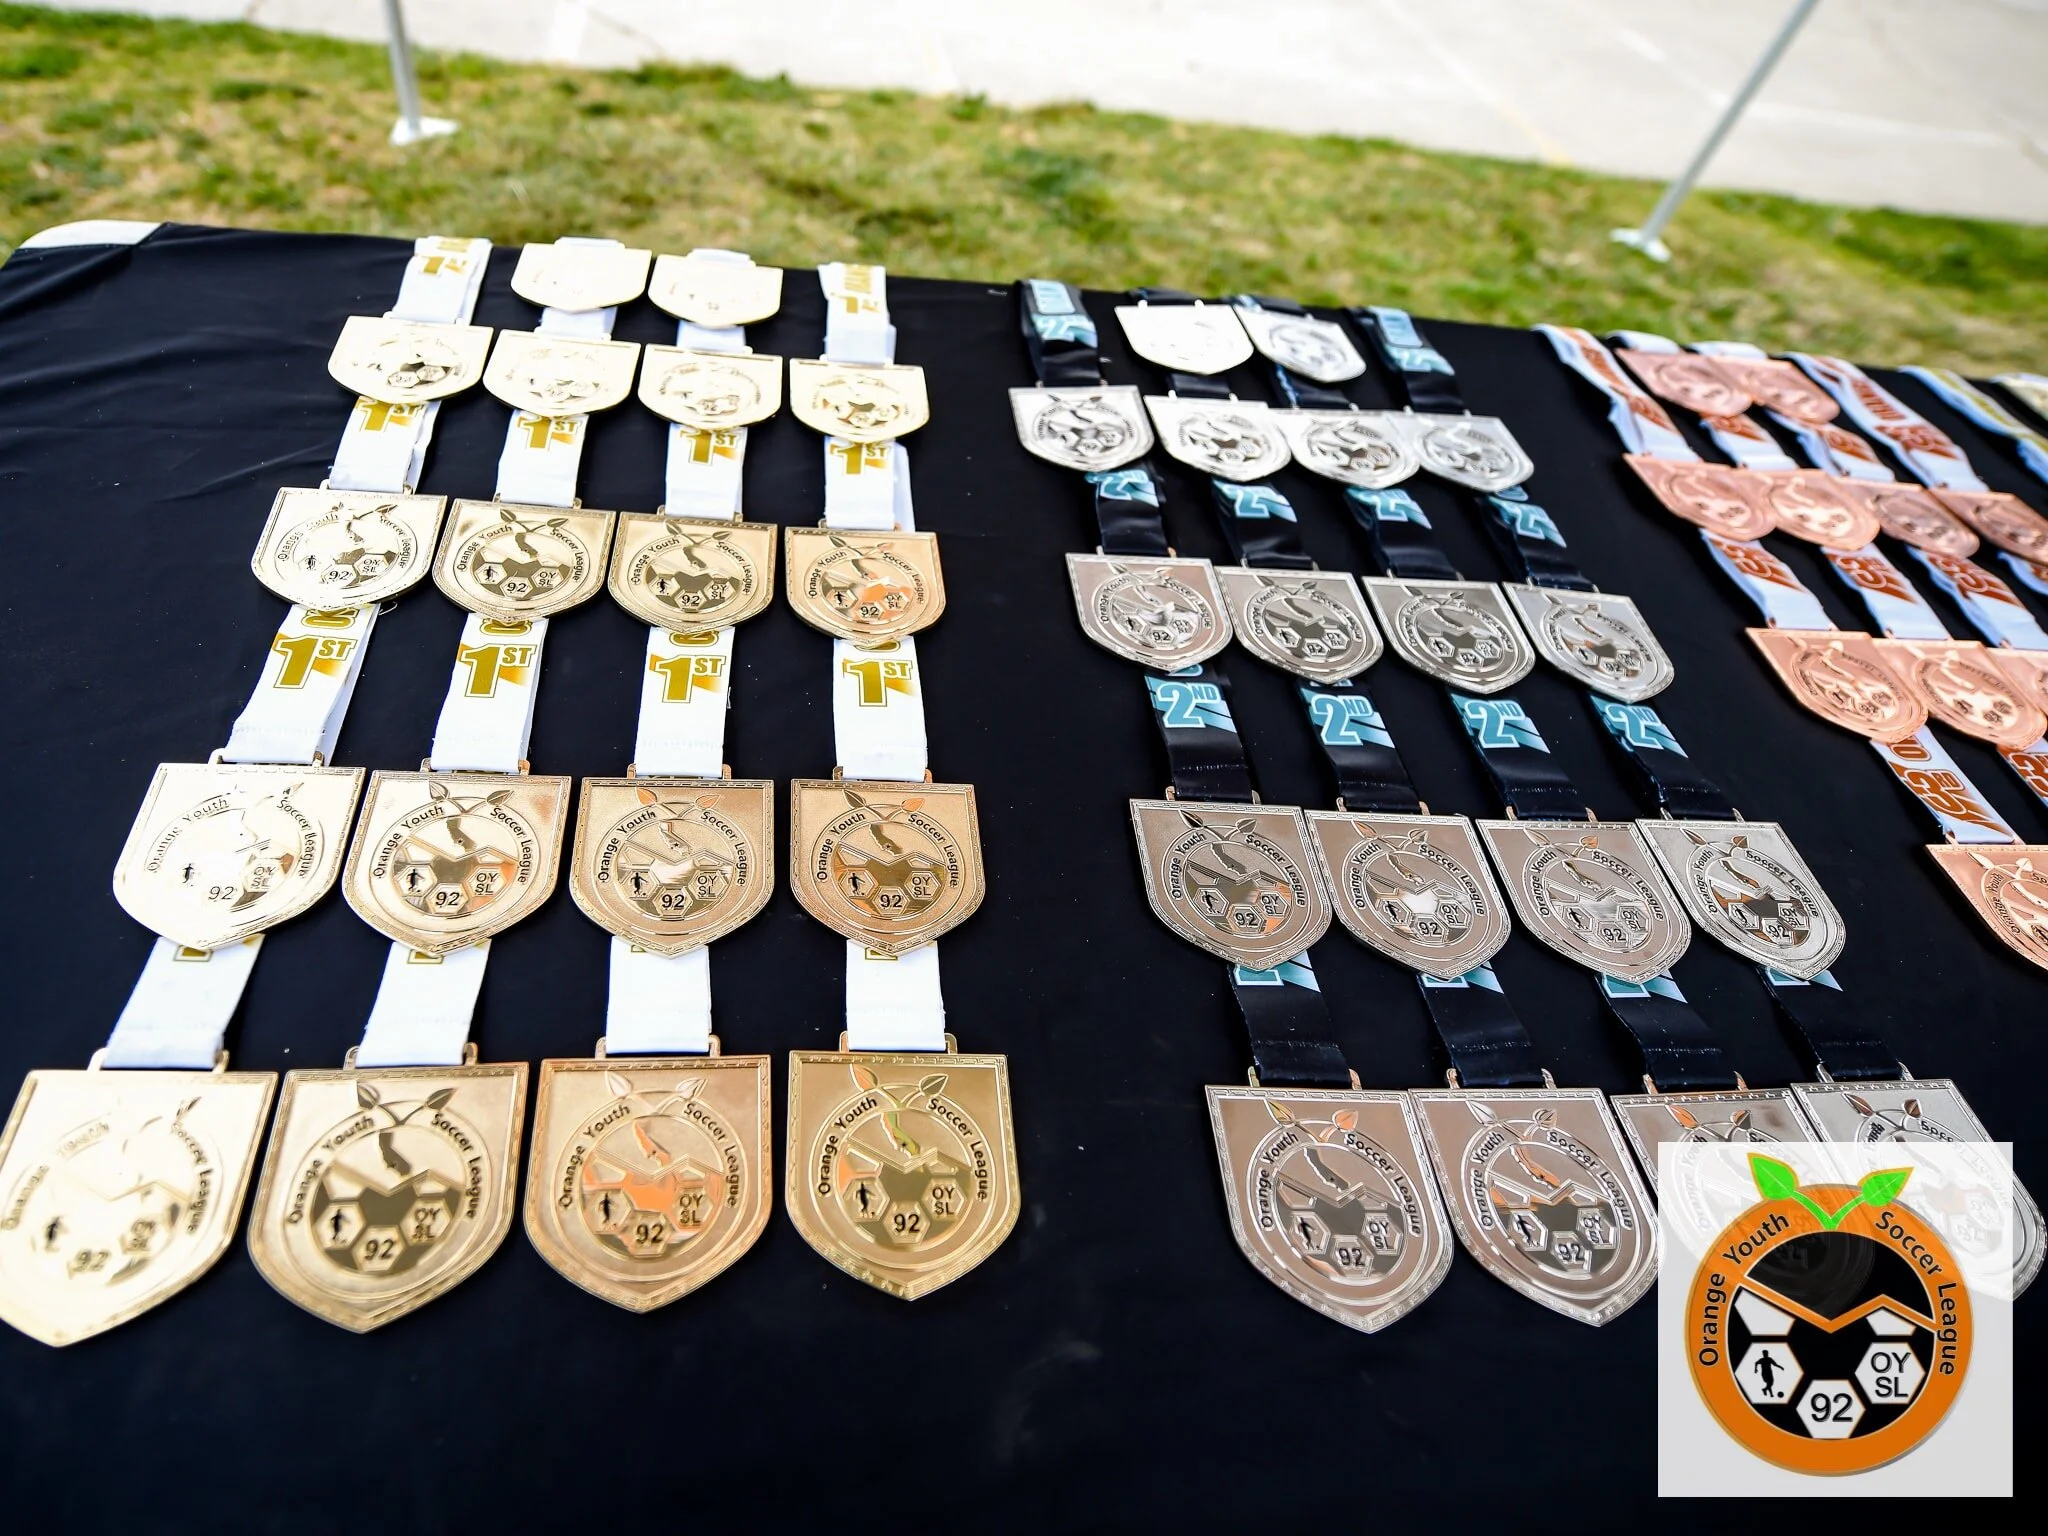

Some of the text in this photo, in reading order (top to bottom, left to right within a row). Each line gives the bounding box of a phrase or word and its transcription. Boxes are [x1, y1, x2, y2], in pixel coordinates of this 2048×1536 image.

[359, 401, 421, 432] 1ST
[521, 416, 581, 450] 1ST
[688, 429, 737, 465] 1ST
[838, 442, 888, 475] 1ST
[457, 525, 584, 582] Orange Youth Soccer League
[328, 569, 350, 581] 92
[538, 571, 557, 579] OY
[629, 537, 753, 595] Orange Youth Soccer League
[506, 581, 528, 593] 92
[538, 578, 552, 587] SL
[810, 551, 924, 604] Orange Youth Soccer League
[681, 595, 700, 605] 92
[711, 591, 725, 601] SL
[860, 605, 879, 617] 92
[1153, 632, 1170, 641] 92
[273, 635, 358, 689] 1ST
[461, 643, 537, 698] 1ST
[655, 654, 726, 703] 1ST
[846, 659, 913, 706] 1ST
[1158, 682, 1220, 728] 2ND
[1312, 694, 1374, 745] 2ND
[1465, 700, 1526, 749] 2ND
[1604, 703, 1663, 749] 2ND
[1904, 769, 1968, 815] 3RD
[372, 805, 534, 884] Orange Youth Soccer League
[598, 808, 748, 887] Orange Youth Soccer League
[817, 811, 959, 888] Orange Youth Soccer League
[476, 872, 498, 883] OY
[1168, 831, 1306, 907] Orange Youth Soccer League
[1350, 842, 1485, 916] Orange Youth Soccer League
[475, 883, 494, 896] SL
[697, 875, 718, 886] OY
[911, 876, 931, 886] OY
[1529, 849, 1665, 922] Orange Youth Soccer League
[1693, 849, 1819, 918] Orange Youth Soccer League
[435, 891, 460, 907] 92
[698, 885, 716, 897] SL
[913, 885, 931, 897] SL
[1261, 895, 1280, 906] OY
[662, 894, 686, 910] 92
[880, 894, 902, 909] 92
[1264, 904, 1283, 915] SL
[1441, 904, 1459, 915] OY
[1235, 912, 1258, 927] 92
[1418, 921, 1442, 937] 92
[1443, 914, 1463, 925] SL
[1603, 927, 1627, 943] 92
[1765, 924, 1791, 940] 92
[559, 1102, 740, 1209] Orange Youth Soccer League
[818, 1096, 988, 1202] Orange Youth Soccer League
[1472, 1132, 1505, 1164] Youth
[1549, 1130, 1597, 1169] Soccer
[287, 1112, 482, 1224] Orange Youth Soccer League
[931, 1186, 956, 1200] OY
[1260, 1131, 1421, 1236] Orange Youth Soccer League
[679, 1193, 703, 1209] OY
[933, 1200, 956, 1216] SL
[1471, 1168, 1493, 1230] Orange
[1600, 1171, 1633, 1230] League
[680, 1209, 702, 1226] SL
[893, 1213, 921, 1233] 92
[1369, 1220, 1390, 1235] OY
[636, 1223, 664, 1244] 92
[1375, 1235, 1394, 1250] SL
[365, 1239, 395, 1260] 92
[1339, 1247, 1366, 1266] 92
[1556, 1243, 1585, 1261] 92
